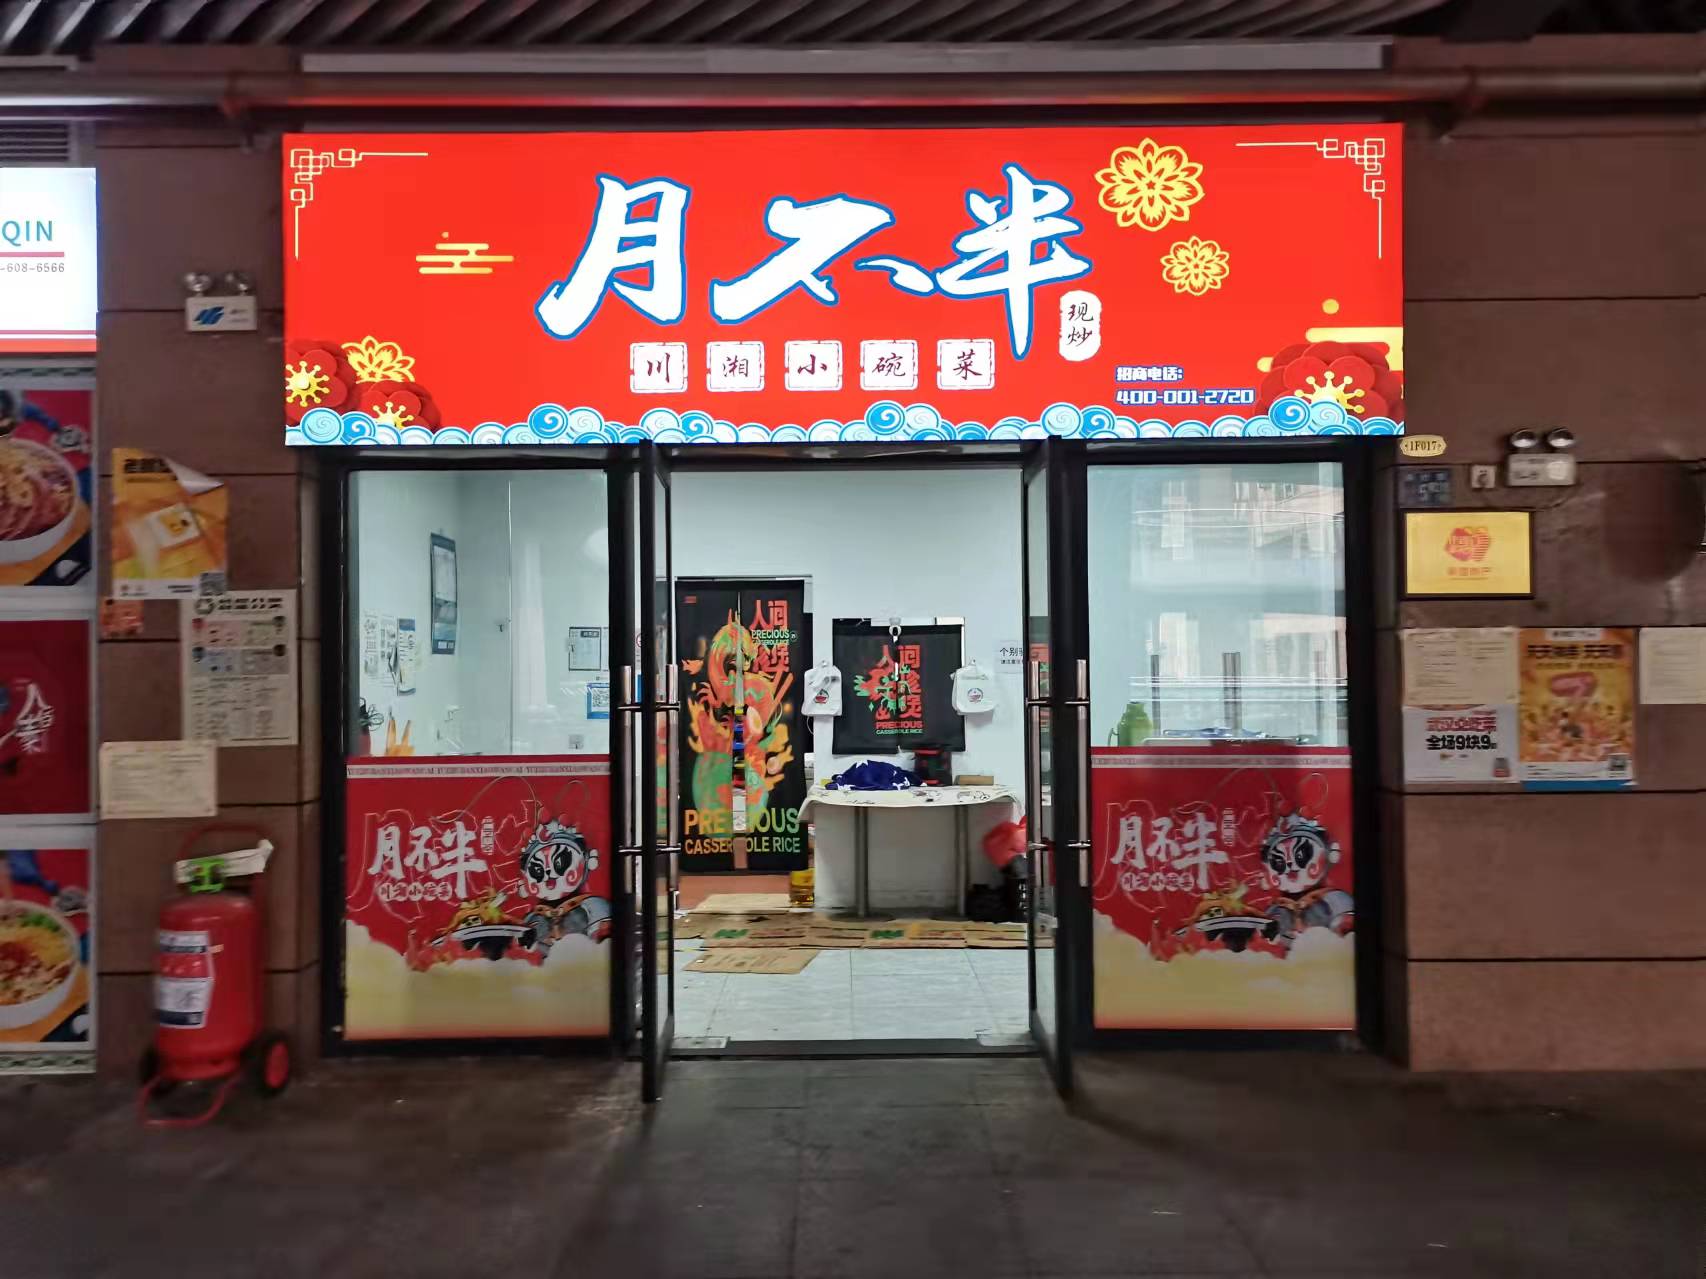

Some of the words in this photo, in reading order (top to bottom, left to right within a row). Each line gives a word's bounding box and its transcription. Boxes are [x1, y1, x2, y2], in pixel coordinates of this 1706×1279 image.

[1066, 301, 1094, 347] 现炒
[646, 349, 983, 384] 川湘小碗菜
[1116, 389, 1254, 404] 400-001-2720
[1410, 440, 1437, 451] 1F017
[751, 629, 790, 639] PRECIOUS
[772, 837, 801, 853] RICE
